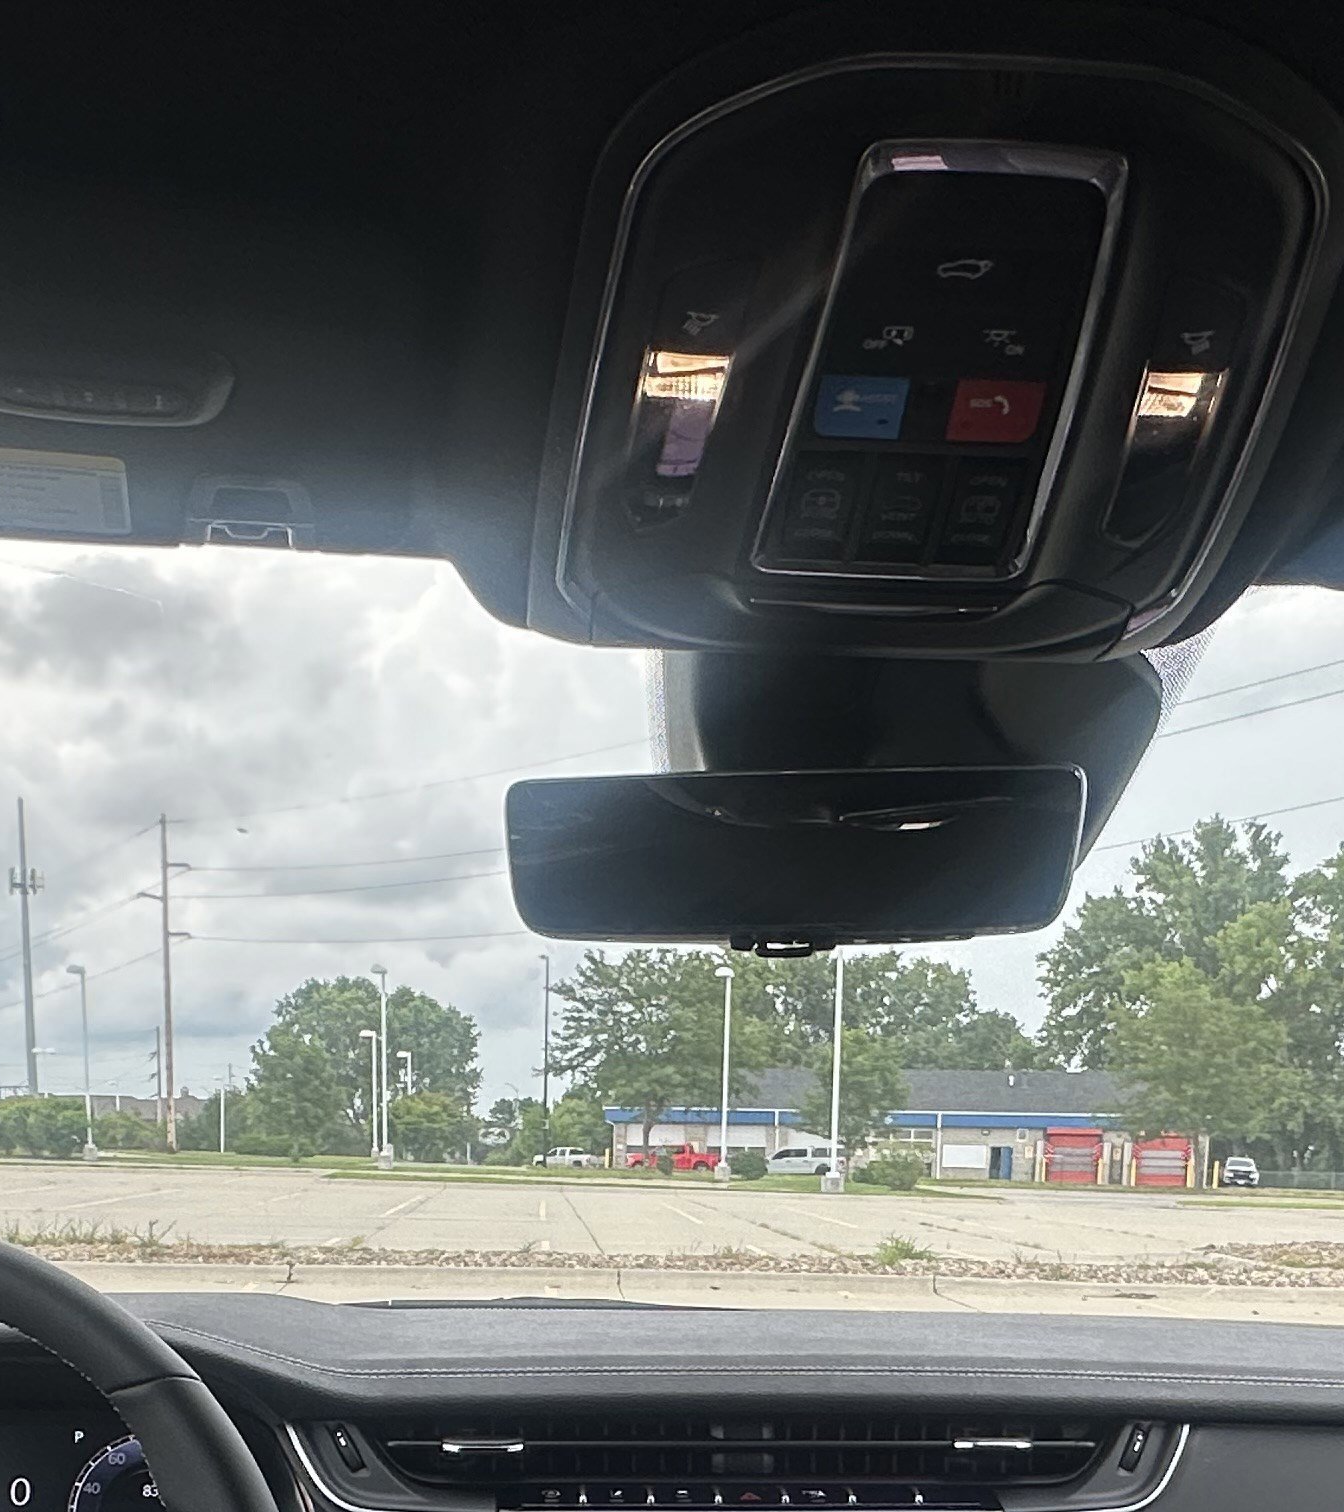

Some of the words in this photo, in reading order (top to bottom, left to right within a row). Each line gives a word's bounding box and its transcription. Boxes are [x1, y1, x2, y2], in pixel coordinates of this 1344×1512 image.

[74, 1431, 85, 1444] P
[107, 1452, 126, 1465] 60
[9, 1477, 32, 1507] 0
[82, 1482, 101, 1495] 40
